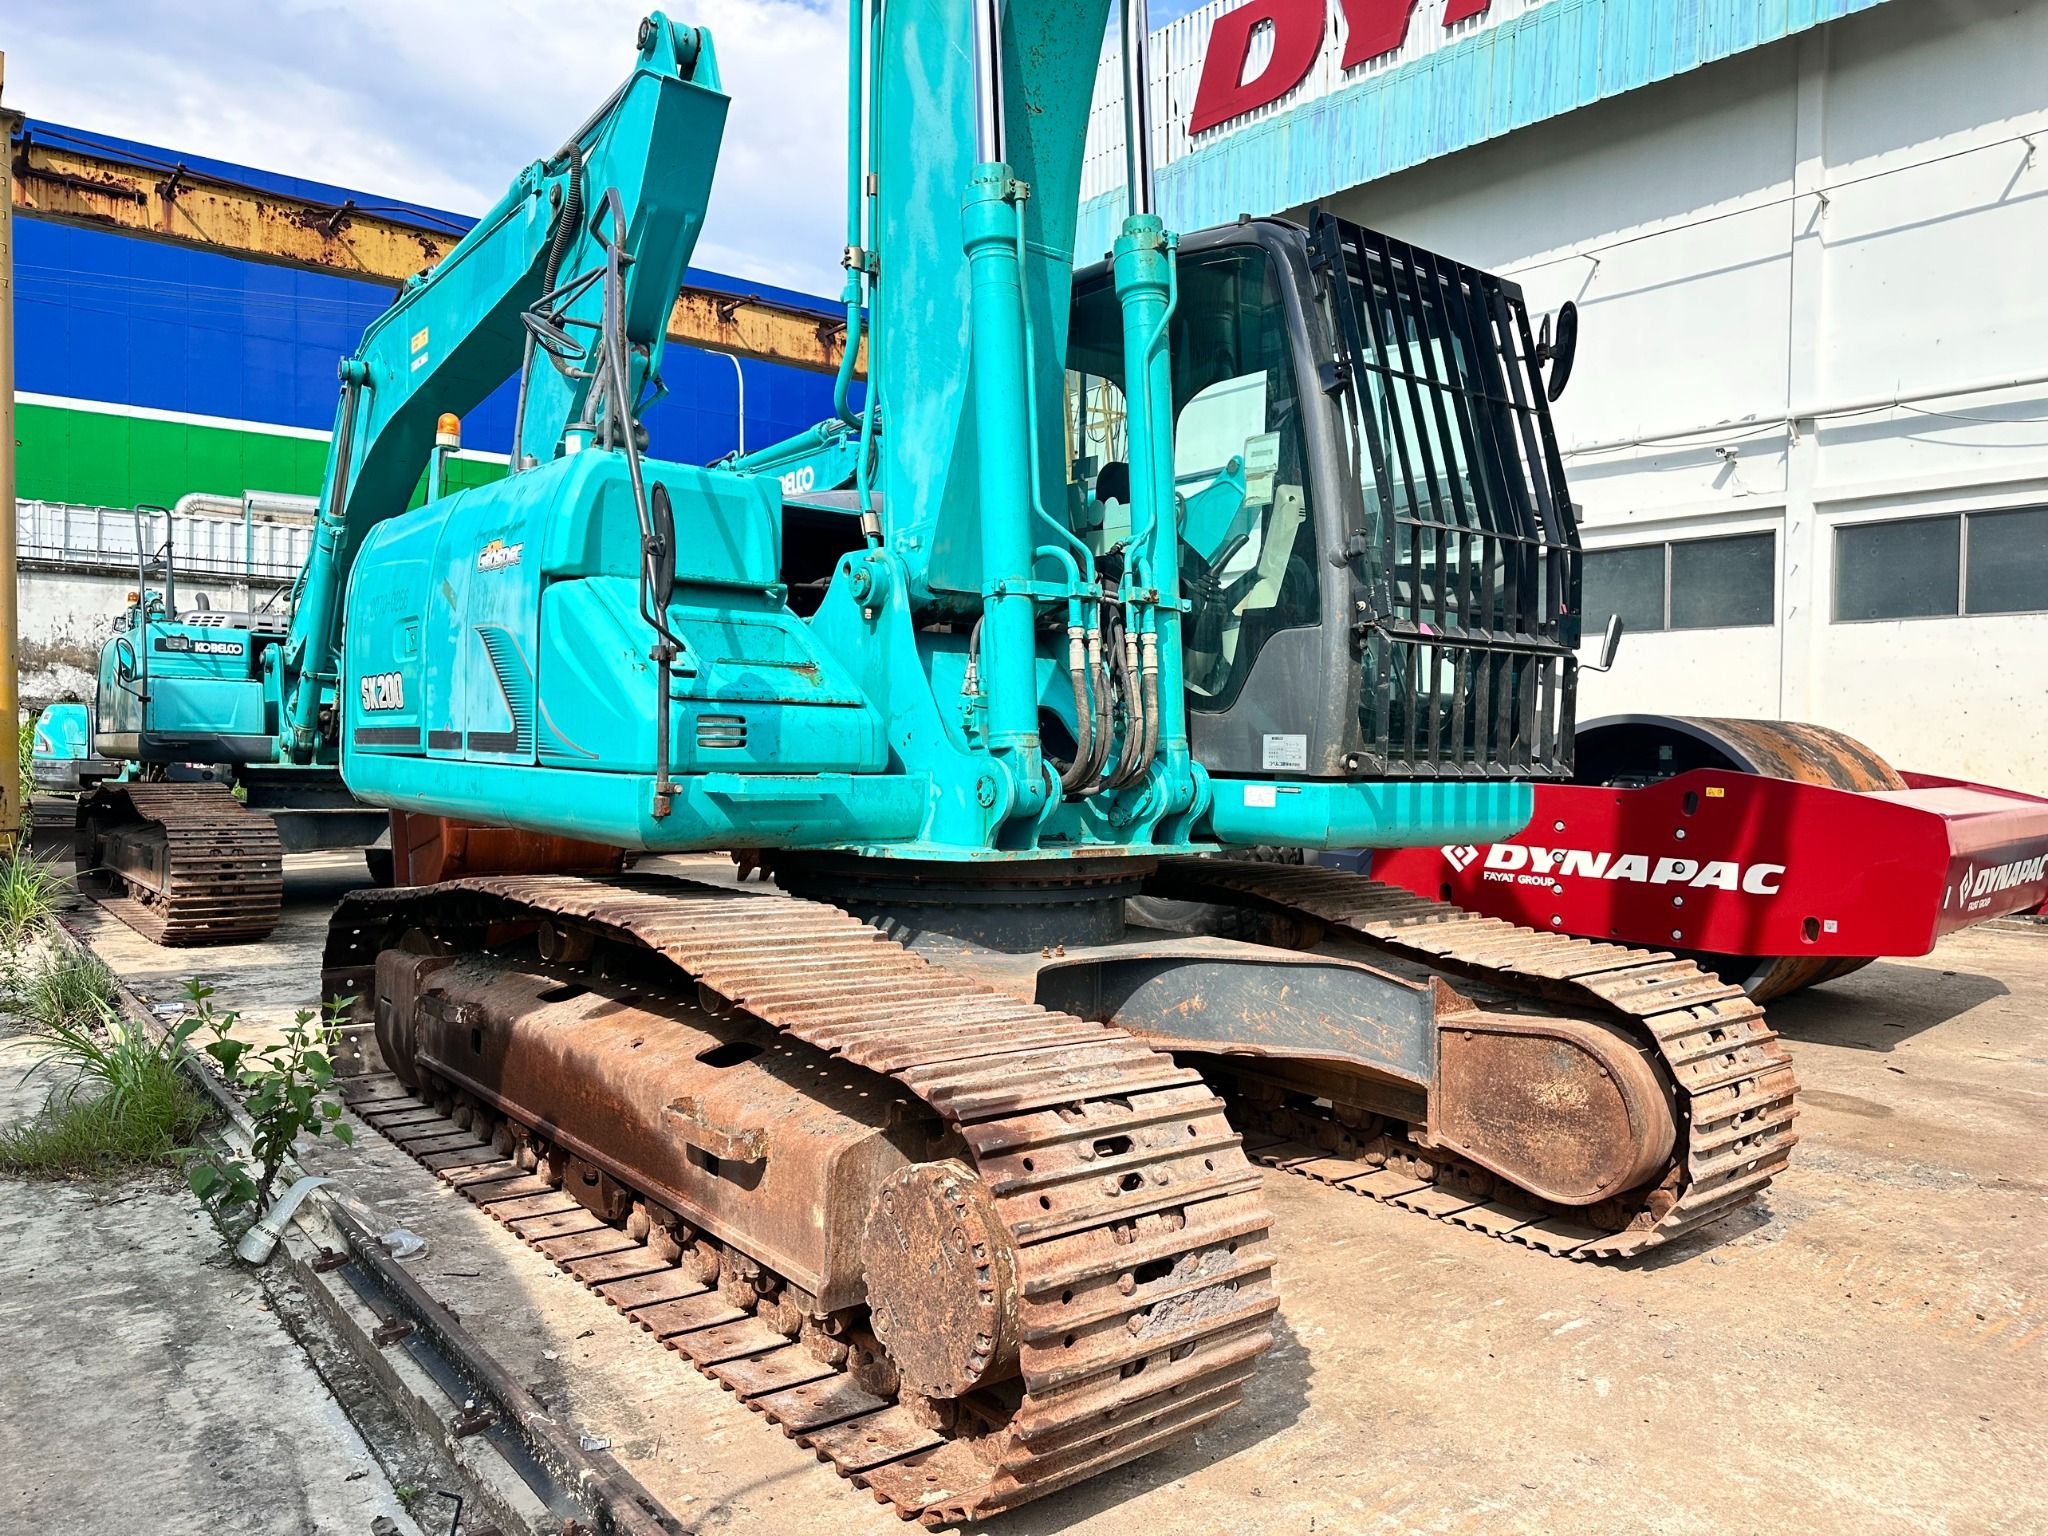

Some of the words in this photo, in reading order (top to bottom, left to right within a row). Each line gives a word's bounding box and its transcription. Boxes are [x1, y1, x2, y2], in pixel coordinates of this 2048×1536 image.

[194, 641, 243, 655] KOBELCO
[361, 671, 404, 711] SK200
[1483, 843, 1787, 895] DYNAPAC
[1483, 870, 1515, 883] FAYAT
[1517, 872, 1556, 887] GROUP
[1971, 853, 2048, 898] DYNAPAC
